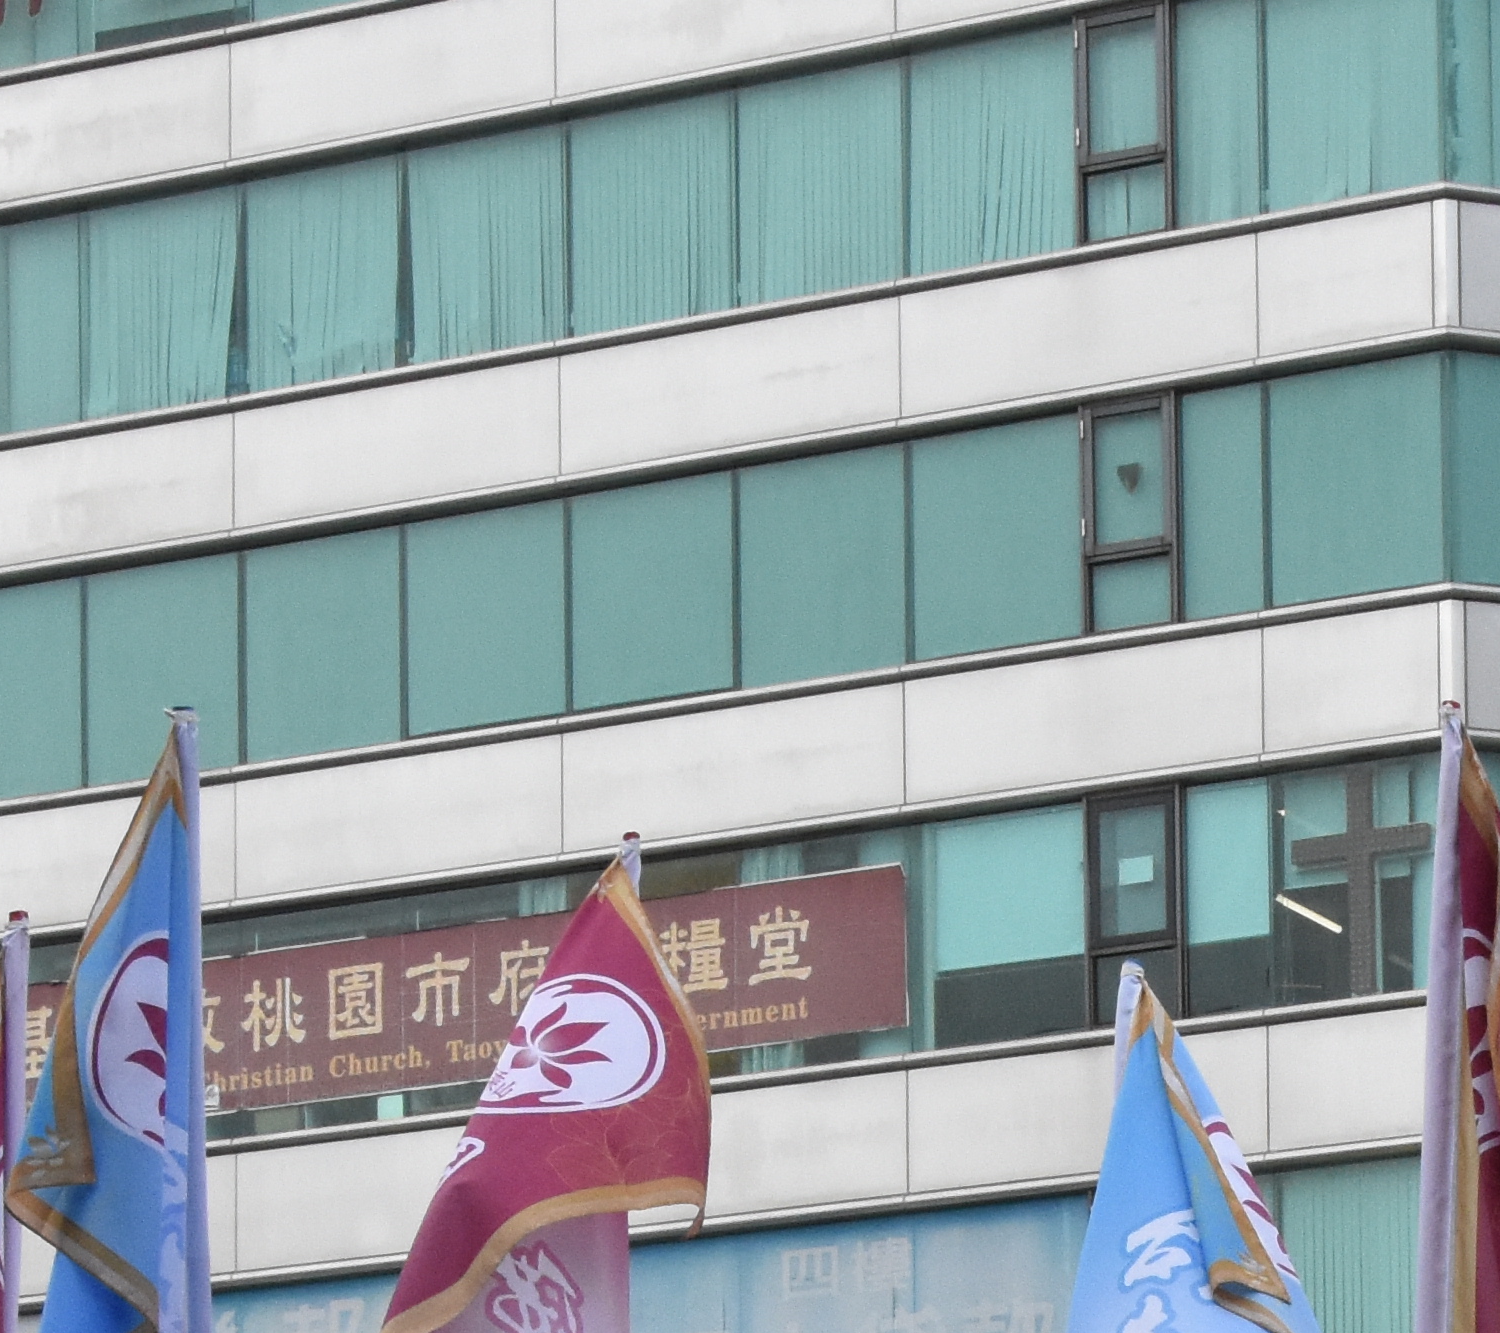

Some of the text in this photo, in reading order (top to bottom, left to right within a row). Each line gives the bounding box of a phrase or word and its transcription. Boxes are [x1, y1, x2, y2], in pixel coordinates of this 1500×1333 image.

[203, 997, 810, 1094] hristian Church, Taoy ernment
